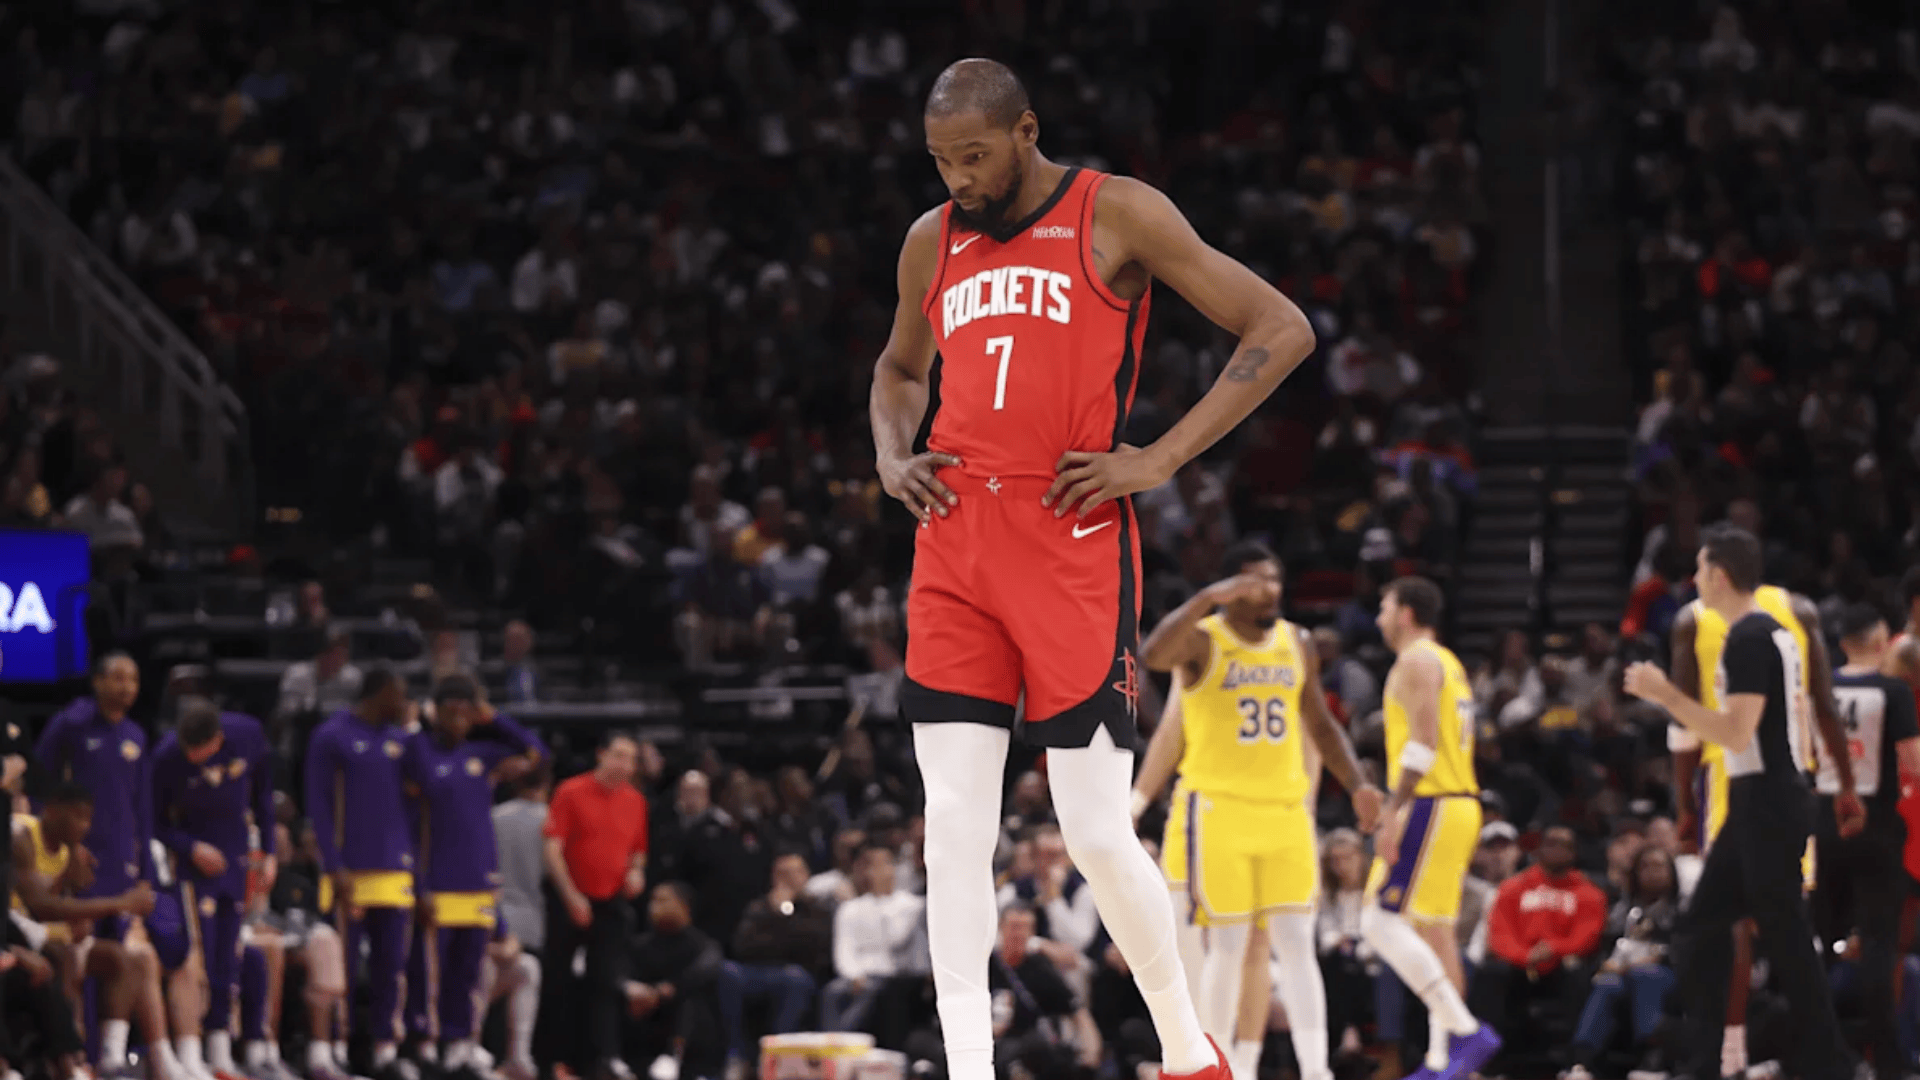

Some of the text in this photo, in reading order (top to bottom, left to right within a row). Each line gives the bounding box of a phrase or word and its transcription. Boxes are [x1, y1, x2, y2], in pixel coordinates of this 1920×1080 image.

[943, 265, 1071, 340] ROCKETS
[985, 335, 1014, 410] 7
[1238, 697, 1287, 741] 36
